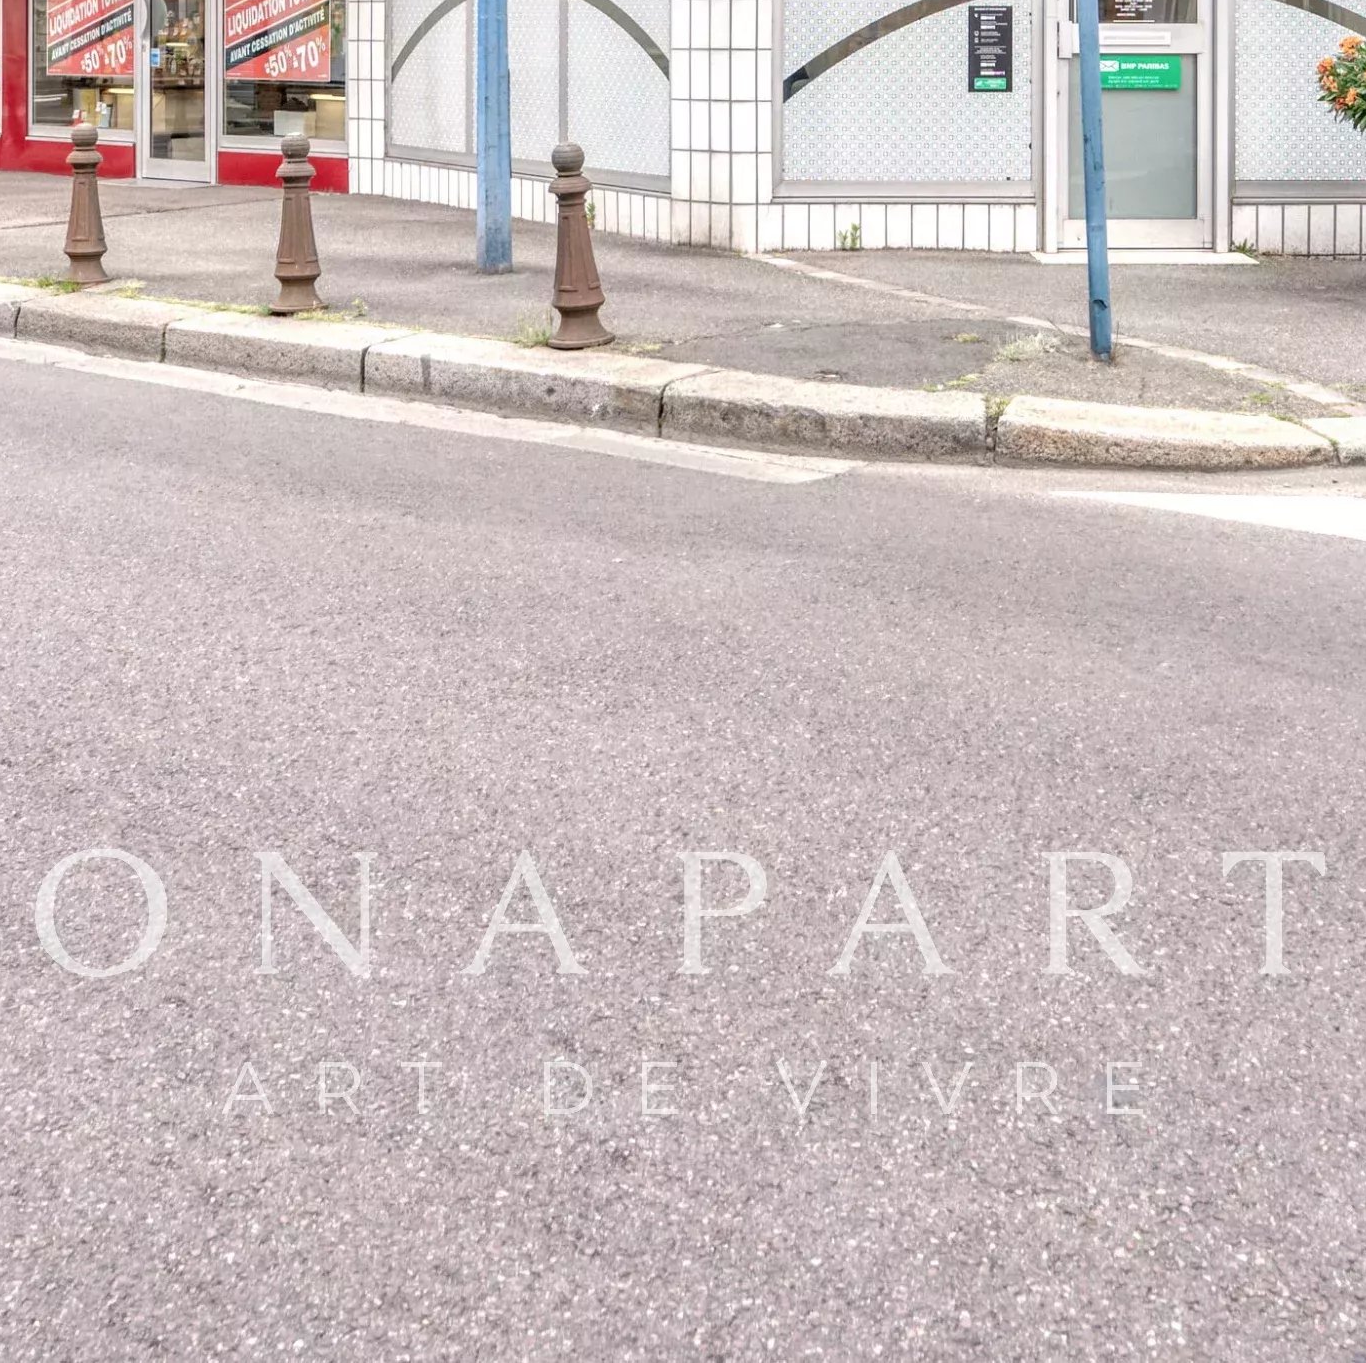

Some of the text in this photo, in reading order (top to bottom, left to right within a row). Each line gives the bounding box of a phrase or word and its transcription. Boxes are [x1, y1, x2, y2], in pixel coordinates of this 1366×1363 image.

[51, 41, 70, 61] AVANT
[70, 26, 101, 55] CESSATION
[230, 43, 251, 63] AVANT
[251, 25, 288, 52] CESSATION
